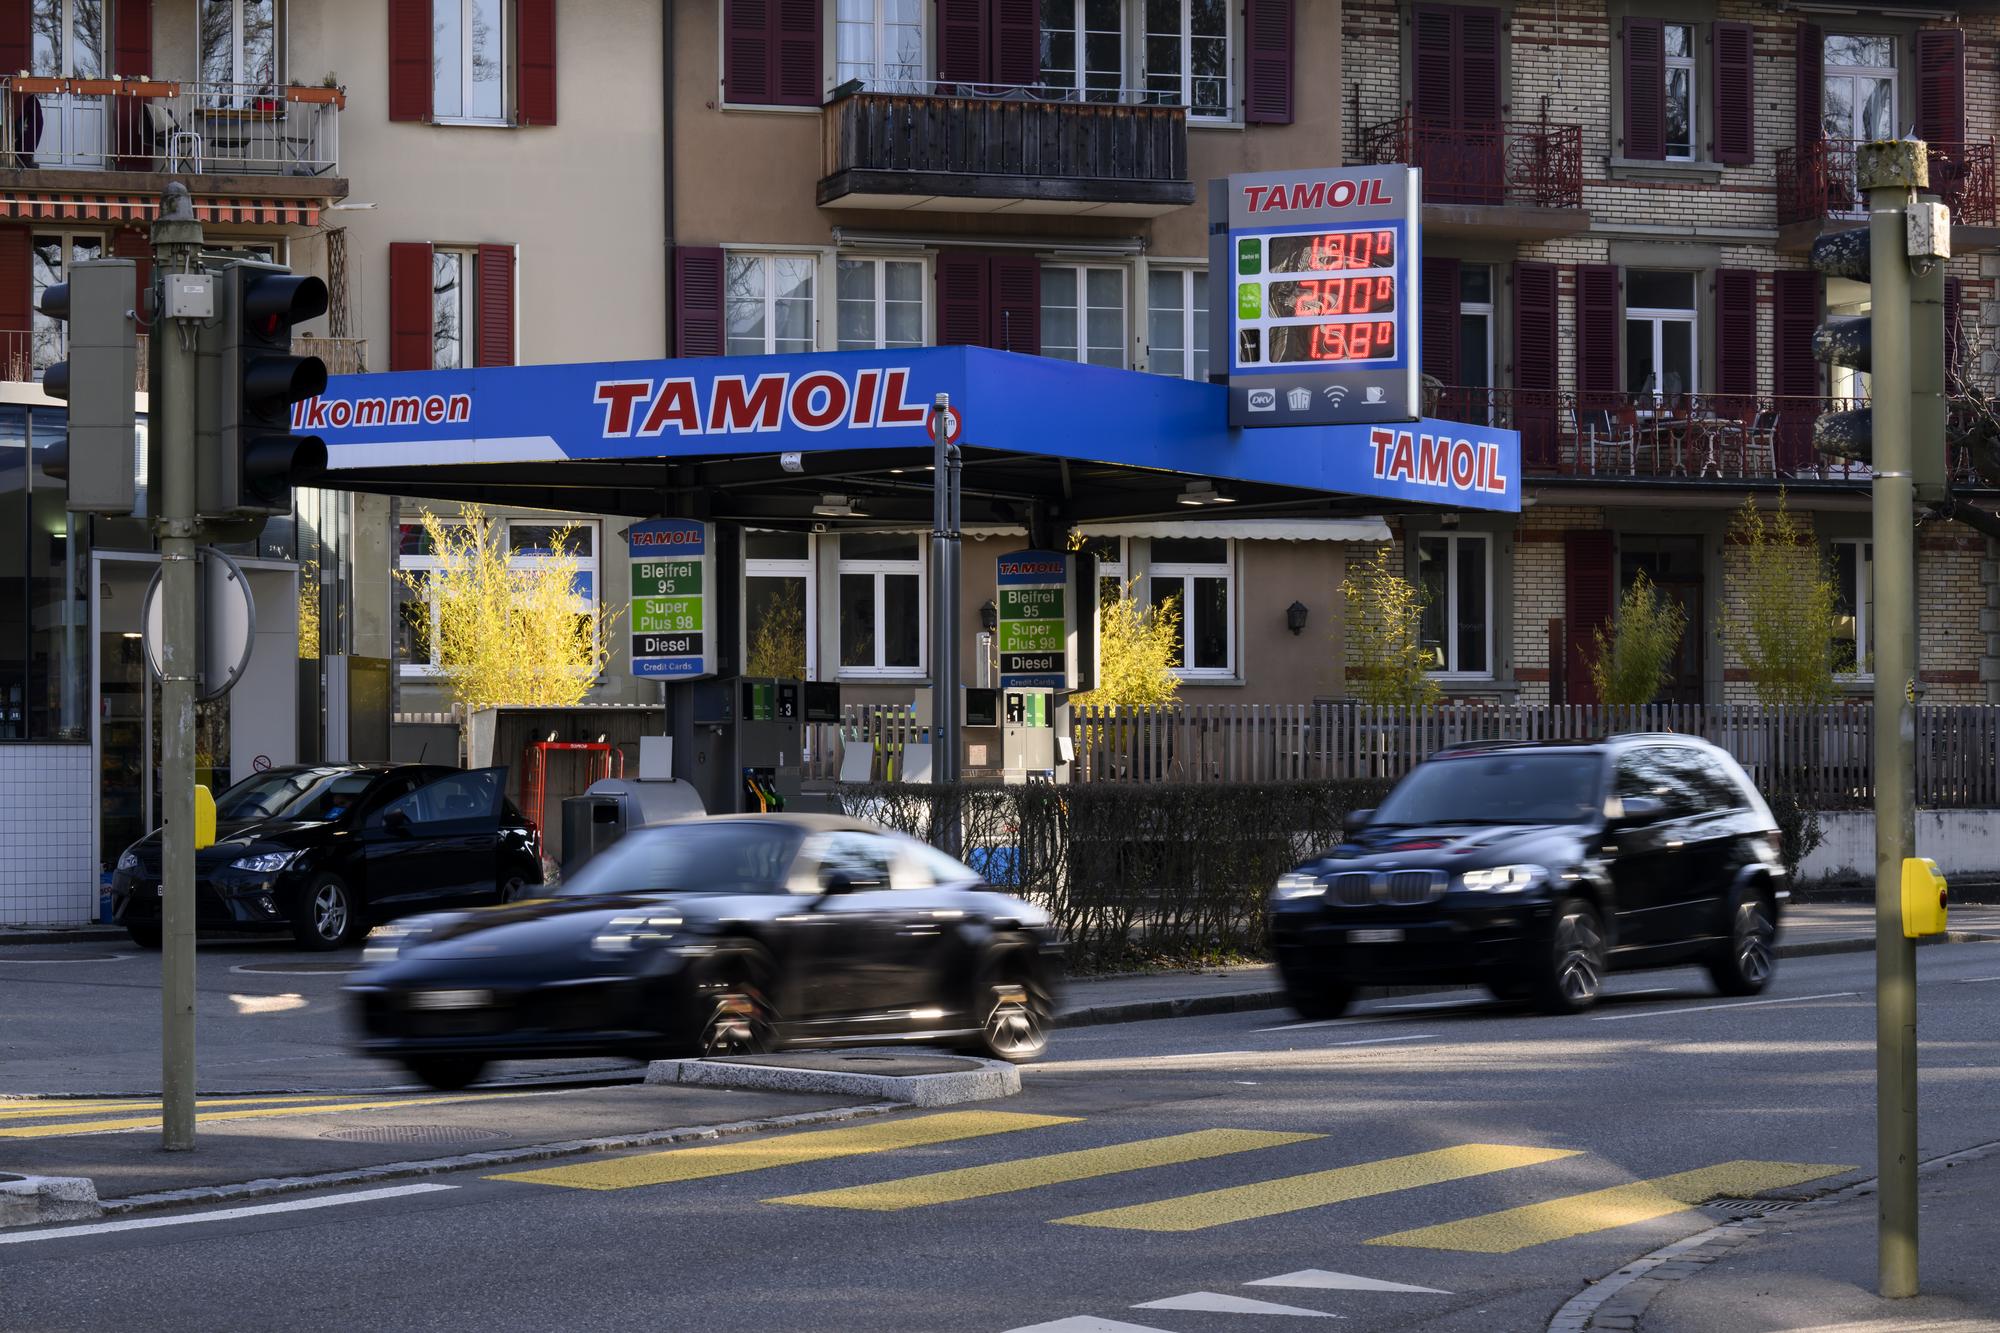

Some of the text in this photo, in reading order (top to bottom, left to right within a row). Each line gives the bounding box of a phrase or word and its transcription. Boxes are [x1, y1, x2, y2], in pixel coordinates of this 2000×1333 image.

[1243, 178, 1393, 213] TAMOIL
[593, 367, 931, 439] TAMOIL
[1251, 395, 1274, 405] DKV
[1369, 426, 1507, 494] TAMOIL
[631, 531, 702, 546] TAMOIL
[641, 563, 692, 579] Bleifrei
[1000, 562, 1064, 575] TAMOIL
[658, 580, 675, 594] 95
[1008, 590, 1055, 604] Bleifrei
[645, 600, 689, 616] Super
[1023, 605, 1039, 617] 95
[640, 616, 694, 630] Plus 98
[1012, 623, 1050, 638] Super
[645, 637, 690, 652] Diesel
[1008, 637, 1056, 650] Plus 98
[643, 662, 692, 671] Credit Cards
[1012, 656, 1053, 669] Diesel
[785, 703, 792, 716] 3
[1013, 709, 1018, 722] 1
